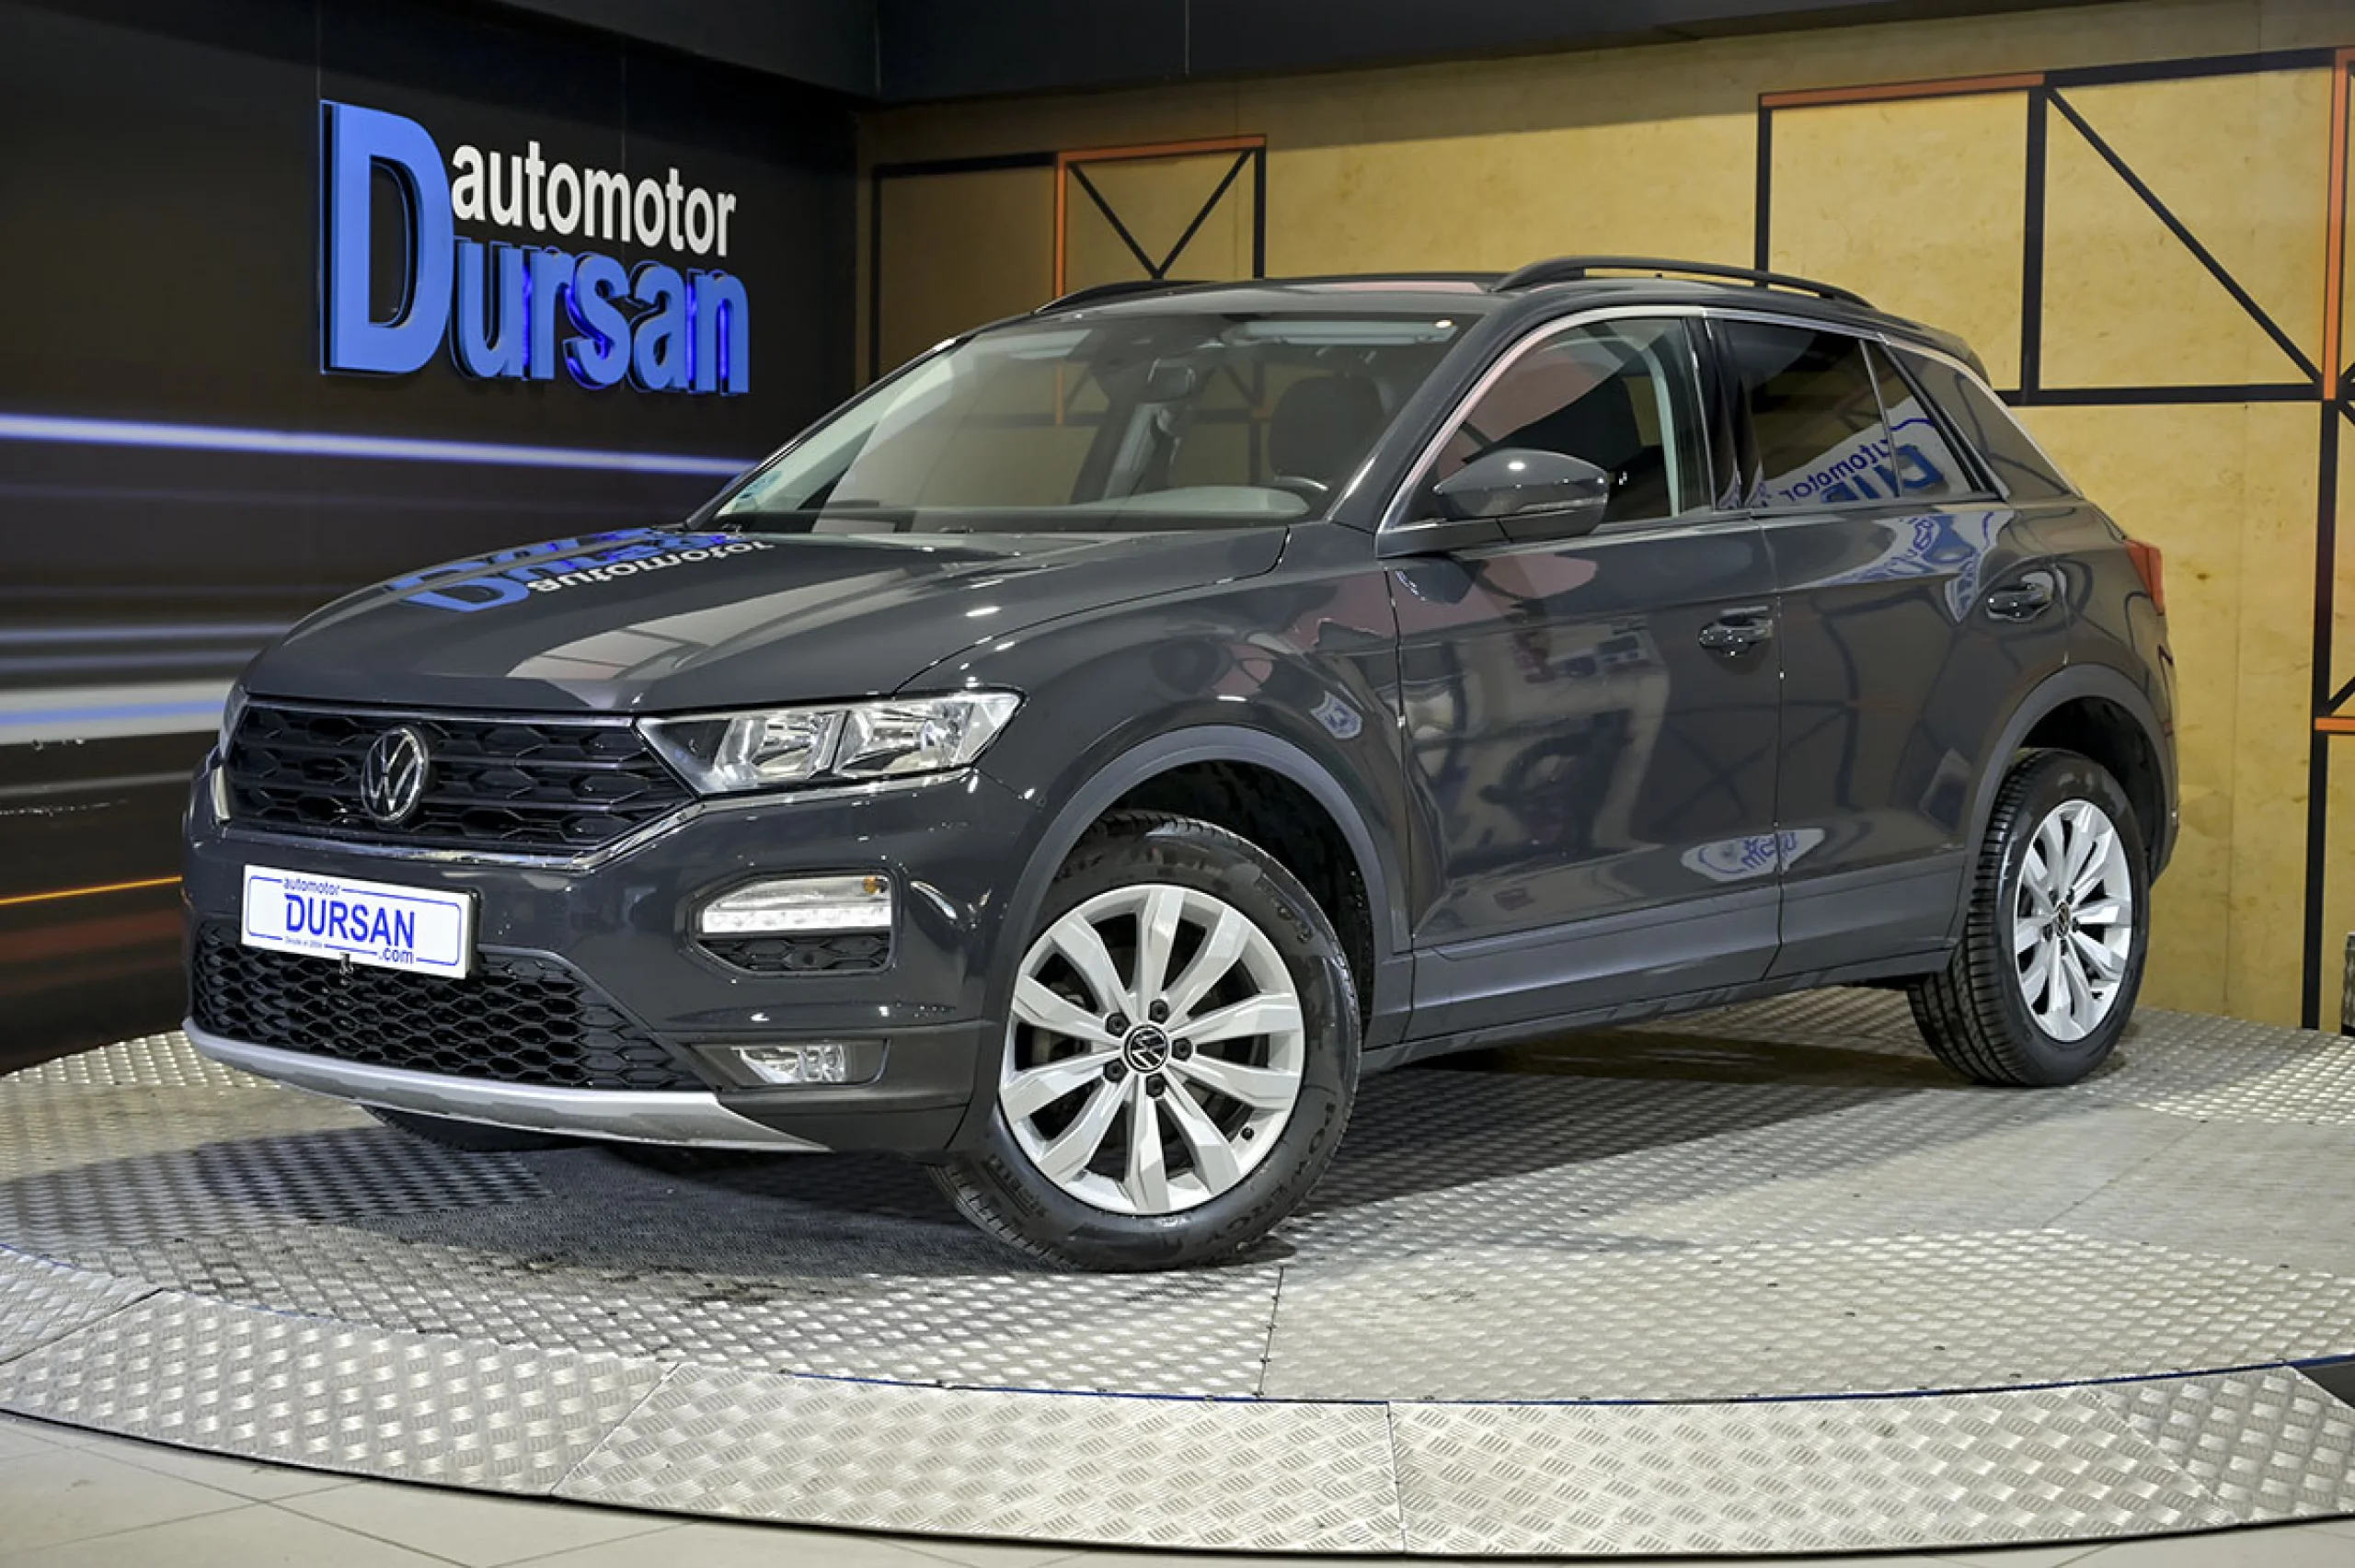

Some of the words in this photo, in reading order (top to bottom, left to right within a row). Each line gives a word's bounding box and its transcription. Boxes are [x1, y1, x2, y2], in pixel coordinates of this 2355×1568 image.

[452, 141, 736, 257] automotor
[320, 99, 749, 396] Dursan
[282, 877, 340, 896] automotor
[284, 893, 415, 949] DURSAN
[379, 947, 414, 965] .com
